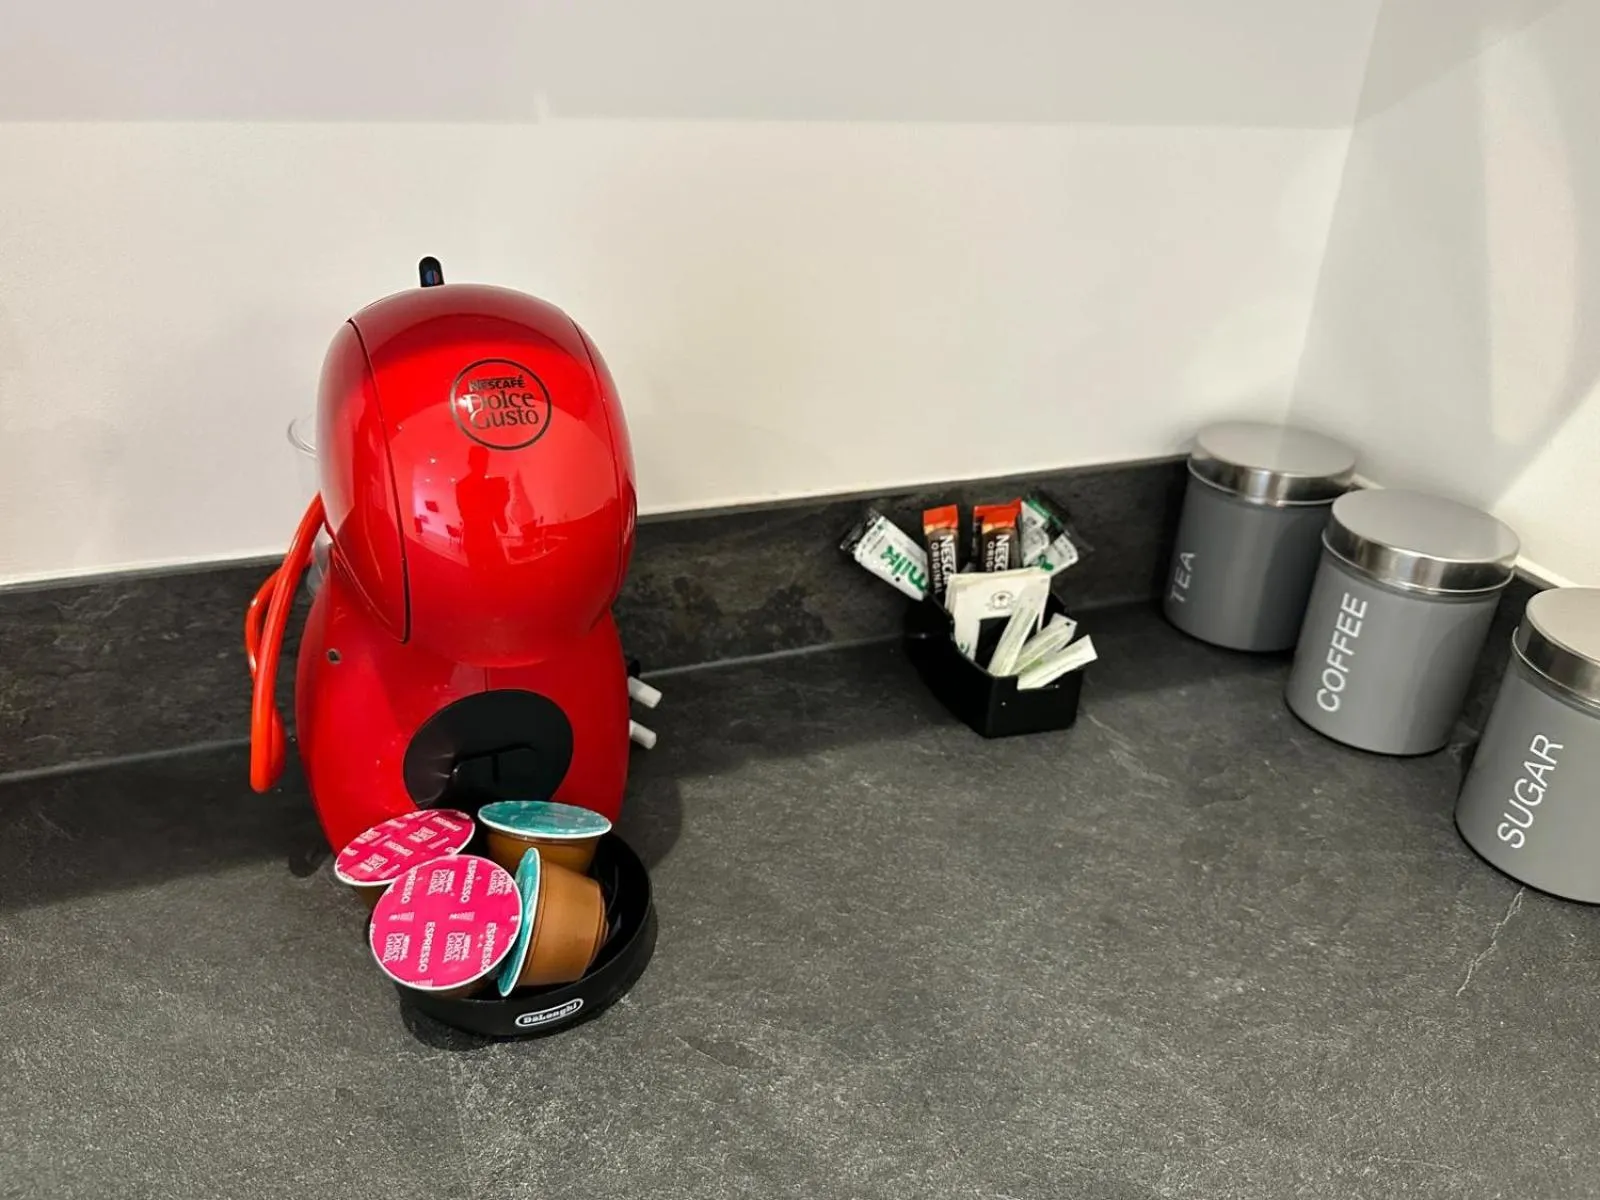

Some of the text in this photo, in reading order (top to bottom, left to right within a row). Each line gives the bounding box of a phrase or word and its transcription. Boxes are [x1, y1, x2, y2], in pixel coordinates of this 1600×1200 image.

[470, 407, 540, 430] Gusto
[880, 545, 928, 592] milk
[994, 534, 1010, 571] NESC
[1170, 552, 1196, 602] TEA
[1316, 592, 1368, 712] COFFEE
[1497, 734, 1564, 849] SUGAR
[460, 859, 478, 903] ESPRESSO
[418, 921, 436, 973] ESPRESSO
